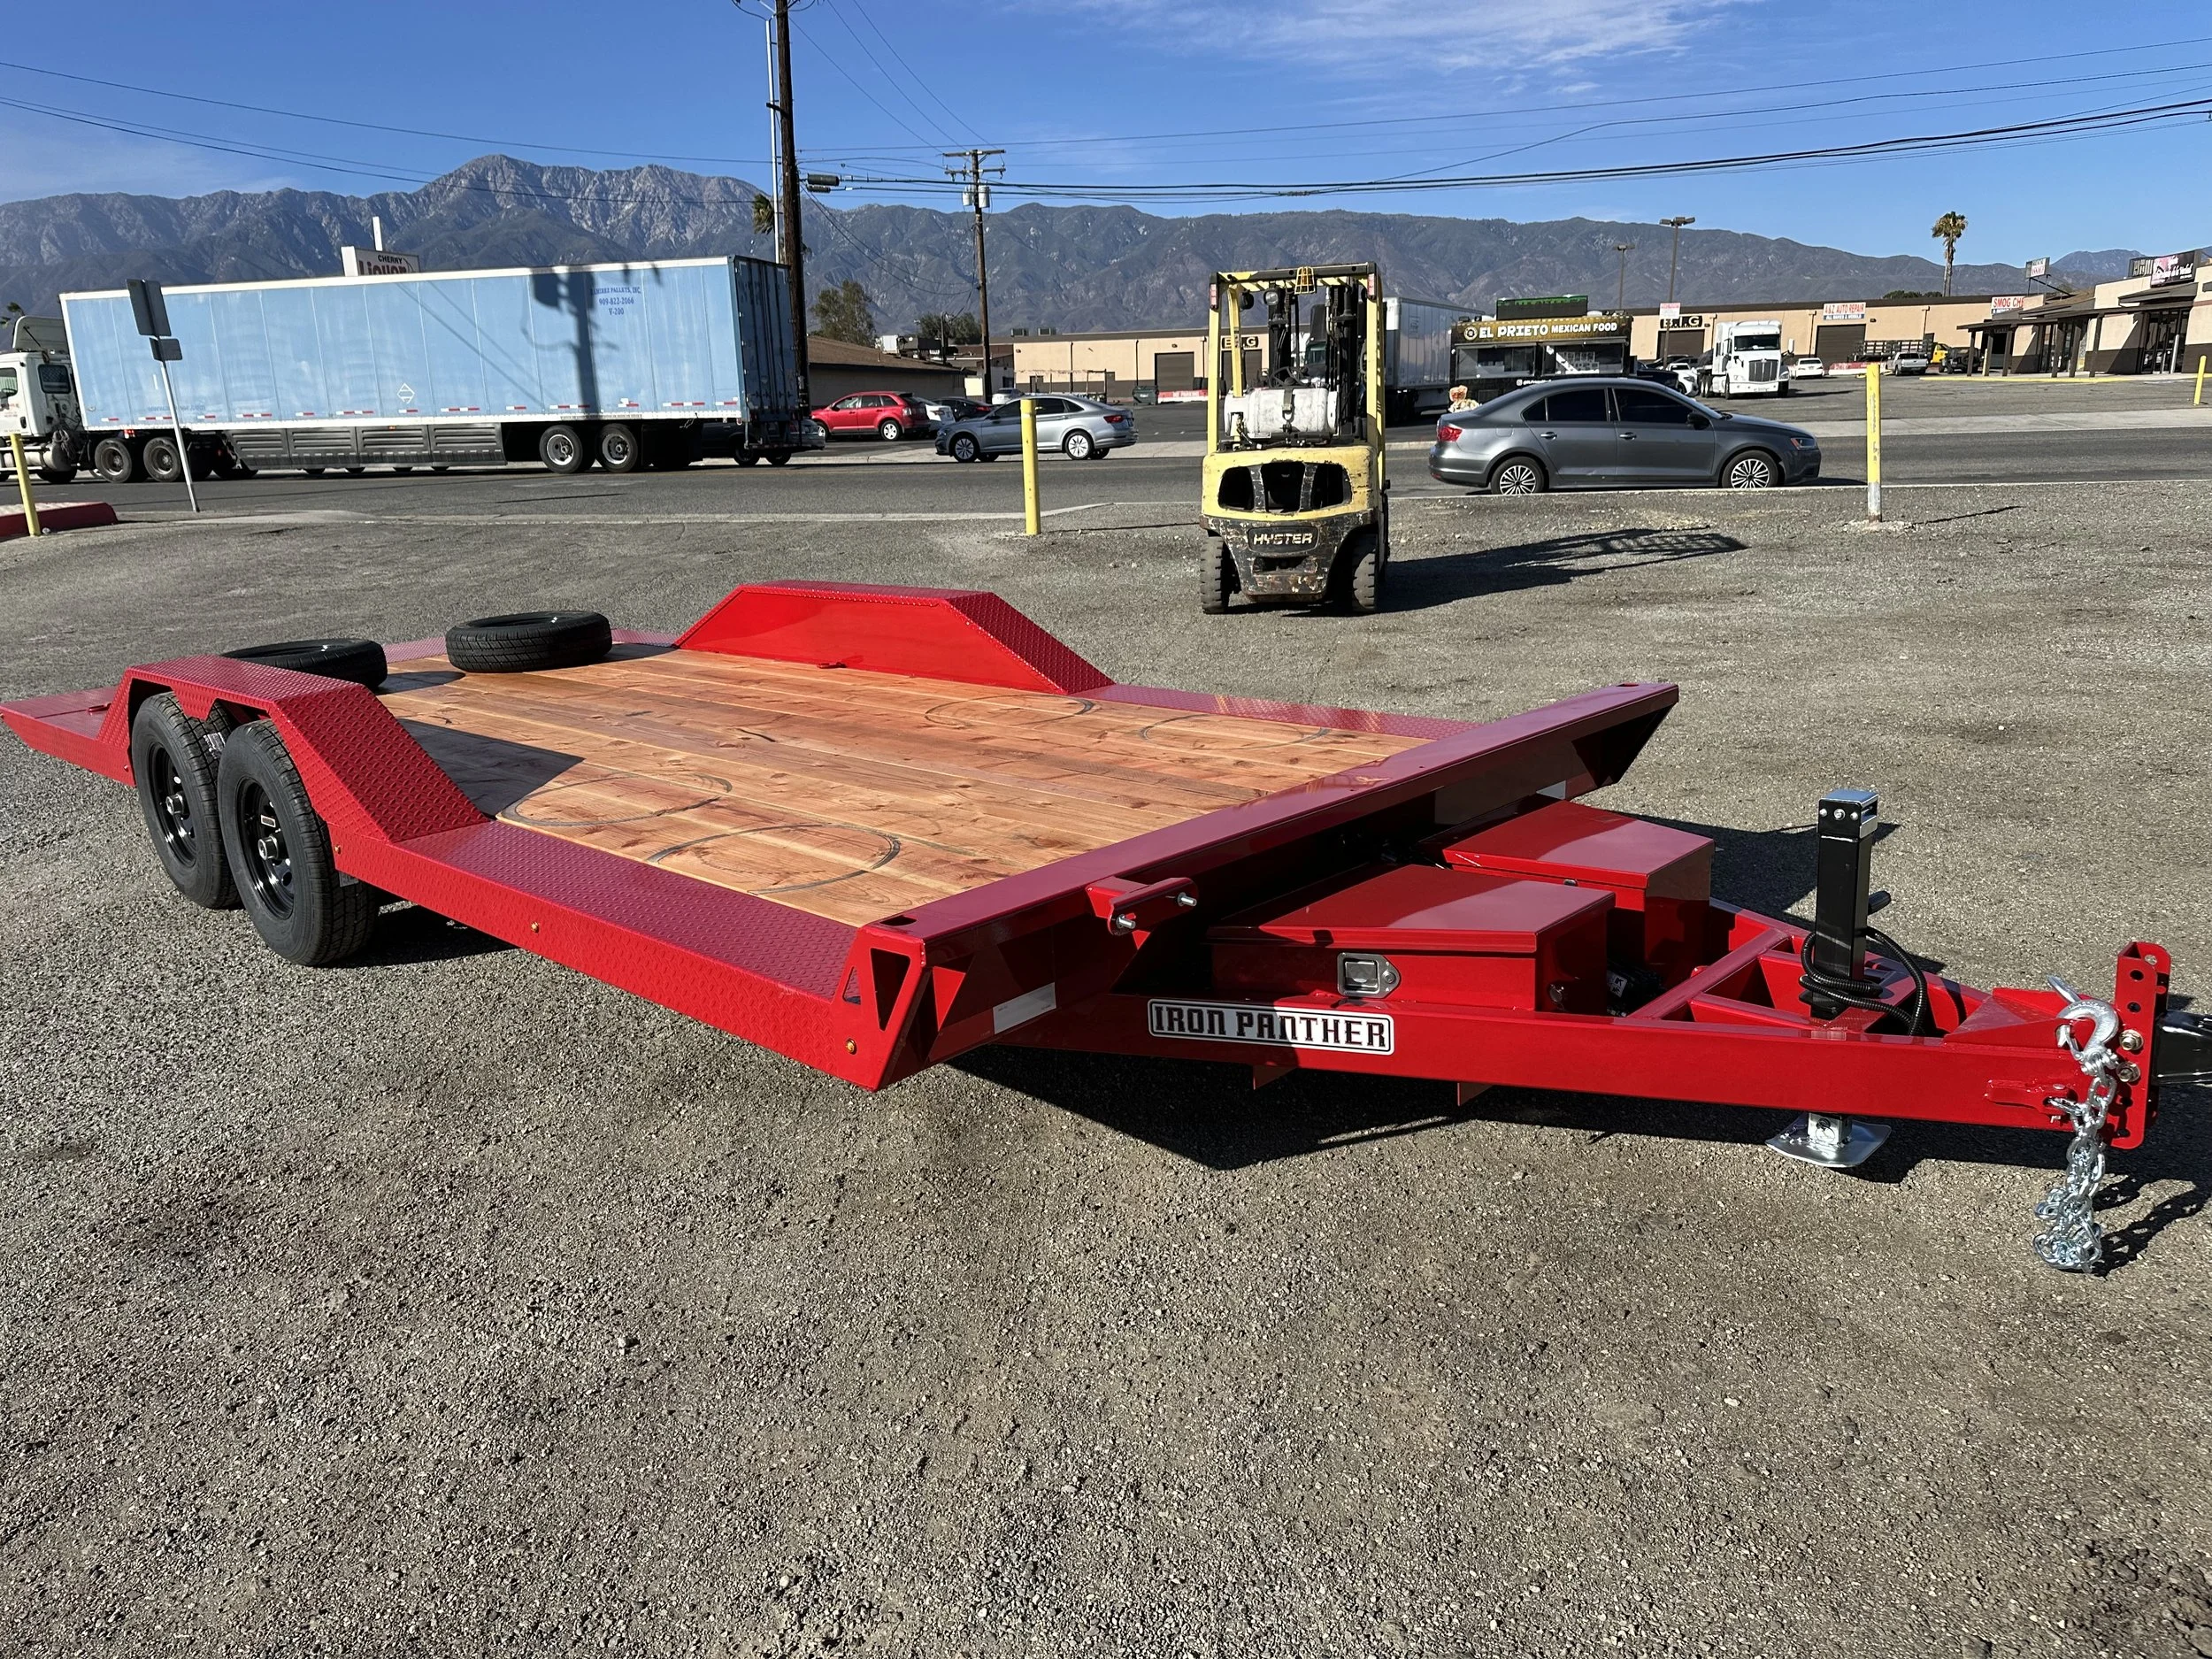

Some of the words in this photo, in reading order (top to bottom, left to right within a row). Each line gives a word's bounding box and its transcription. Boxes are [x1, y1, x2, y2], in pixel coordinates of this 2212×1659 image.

[377, 254, 403, 265] CHERRY
[1836, 304, 1848, 313] AUTO
[1849, 303, 1864, 313] REPAIR
[1993, 297, 2011, 308] SMOG
[1479, 326, 1494, 339] EL
[1497, 325, 1548, 338] PRIETO
[1551, 324, 1591, 334] MEXICAN
[1593, 322, 1617, 332] FOOD
[1253, 533, 1313, 545] HYSTER
[1154, 1005, 1227, 1036] IRON
[1235, 1010, 1387, 1048] PANTHER
